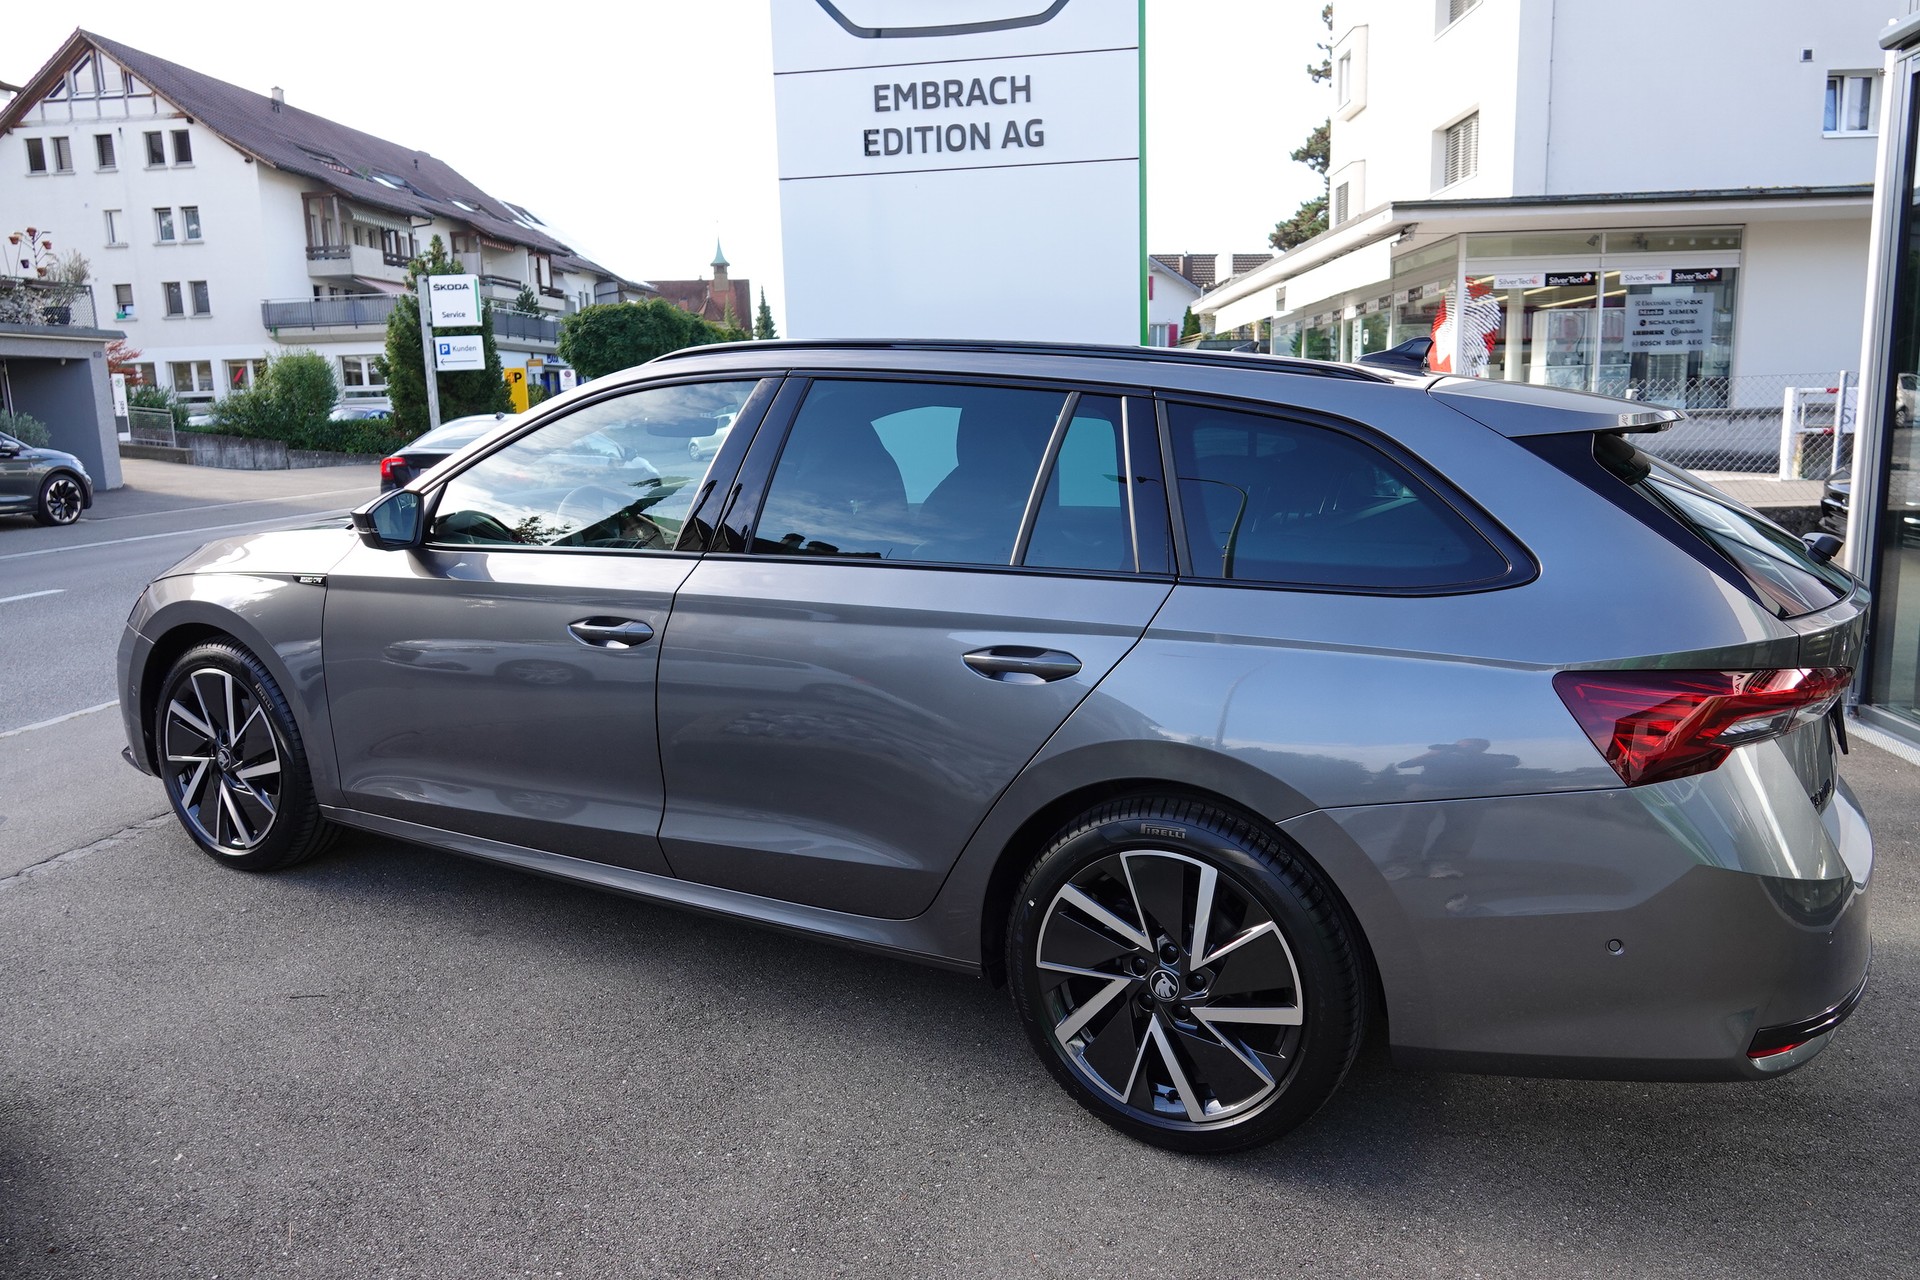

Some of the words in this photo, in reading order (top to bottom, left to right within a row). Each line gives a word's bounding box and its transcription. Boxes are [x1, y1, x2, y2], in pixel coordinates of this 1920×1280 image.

[874, 75, 1031, 112] EMBRACH
[863, 122, 991, 156] EDITION
[1001, 118, 1044, 149] AG
[433, 283, 469, 291] ŠKODA
[1548, 275, 1586, 284] SilverTech
[1141, 823, 1186, 839] PIRELLI
